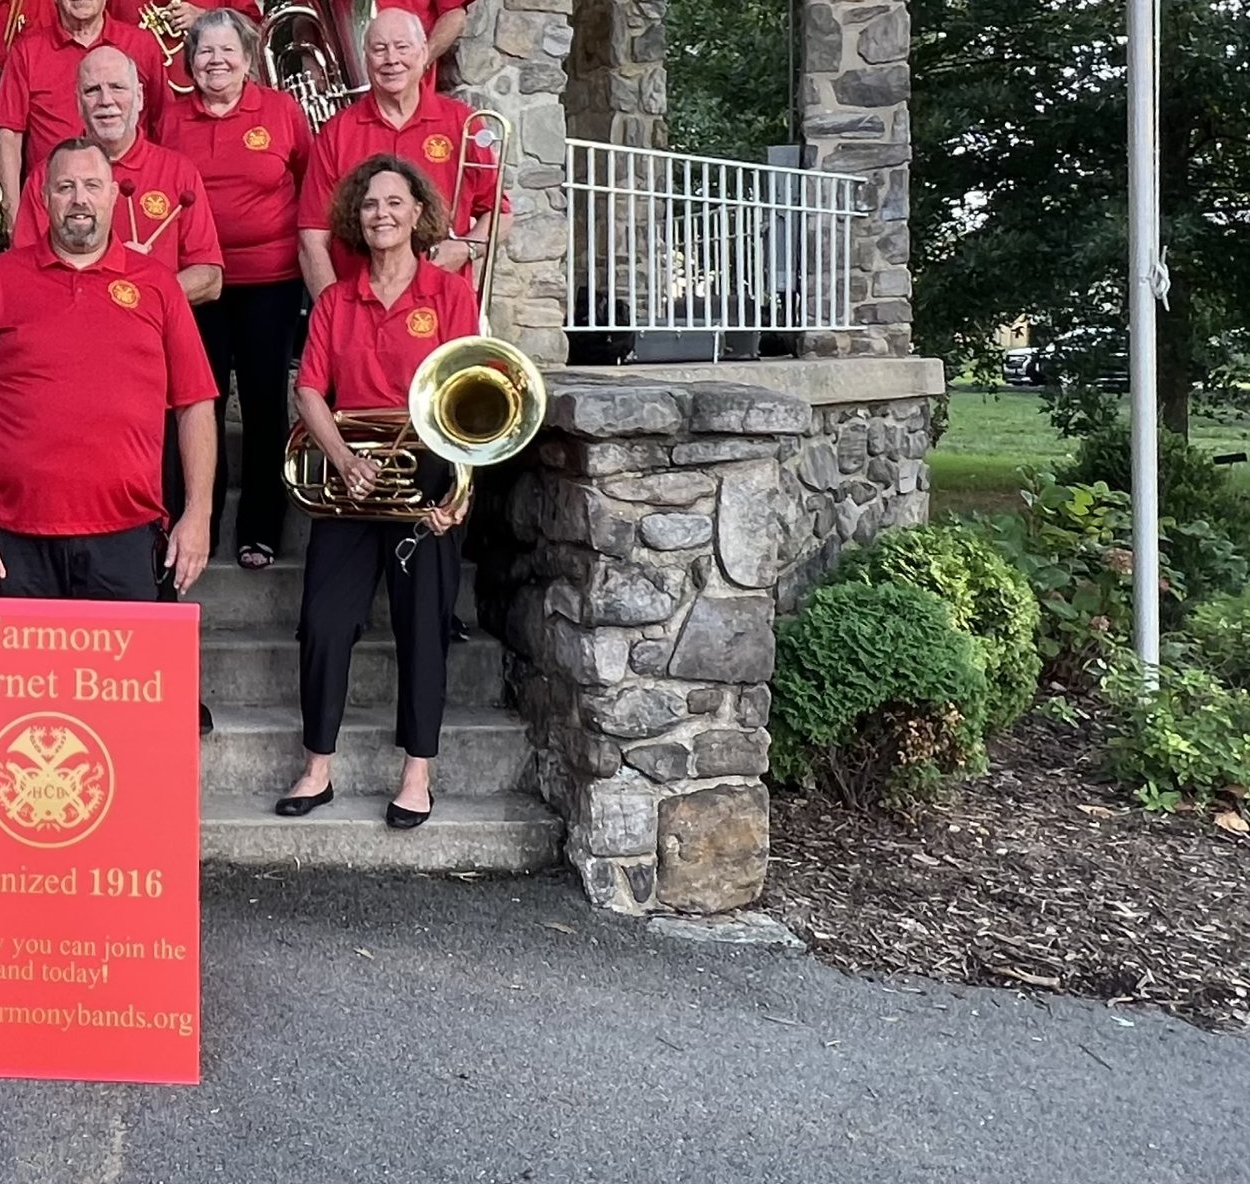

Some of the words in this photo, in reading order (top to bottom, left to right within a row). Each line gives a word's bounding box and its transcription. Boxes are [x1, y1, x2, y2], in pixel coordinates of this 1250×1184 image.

[73, 667, 163, 703] Band
[89, 867, 163, 898] 1916
[12, 937, 52, 962] you
[59, 939, 96, 958] can
[100, 935, 145, 963] join
[153, 937, 187, 961] the
[41, 960, 109, 989] today!
